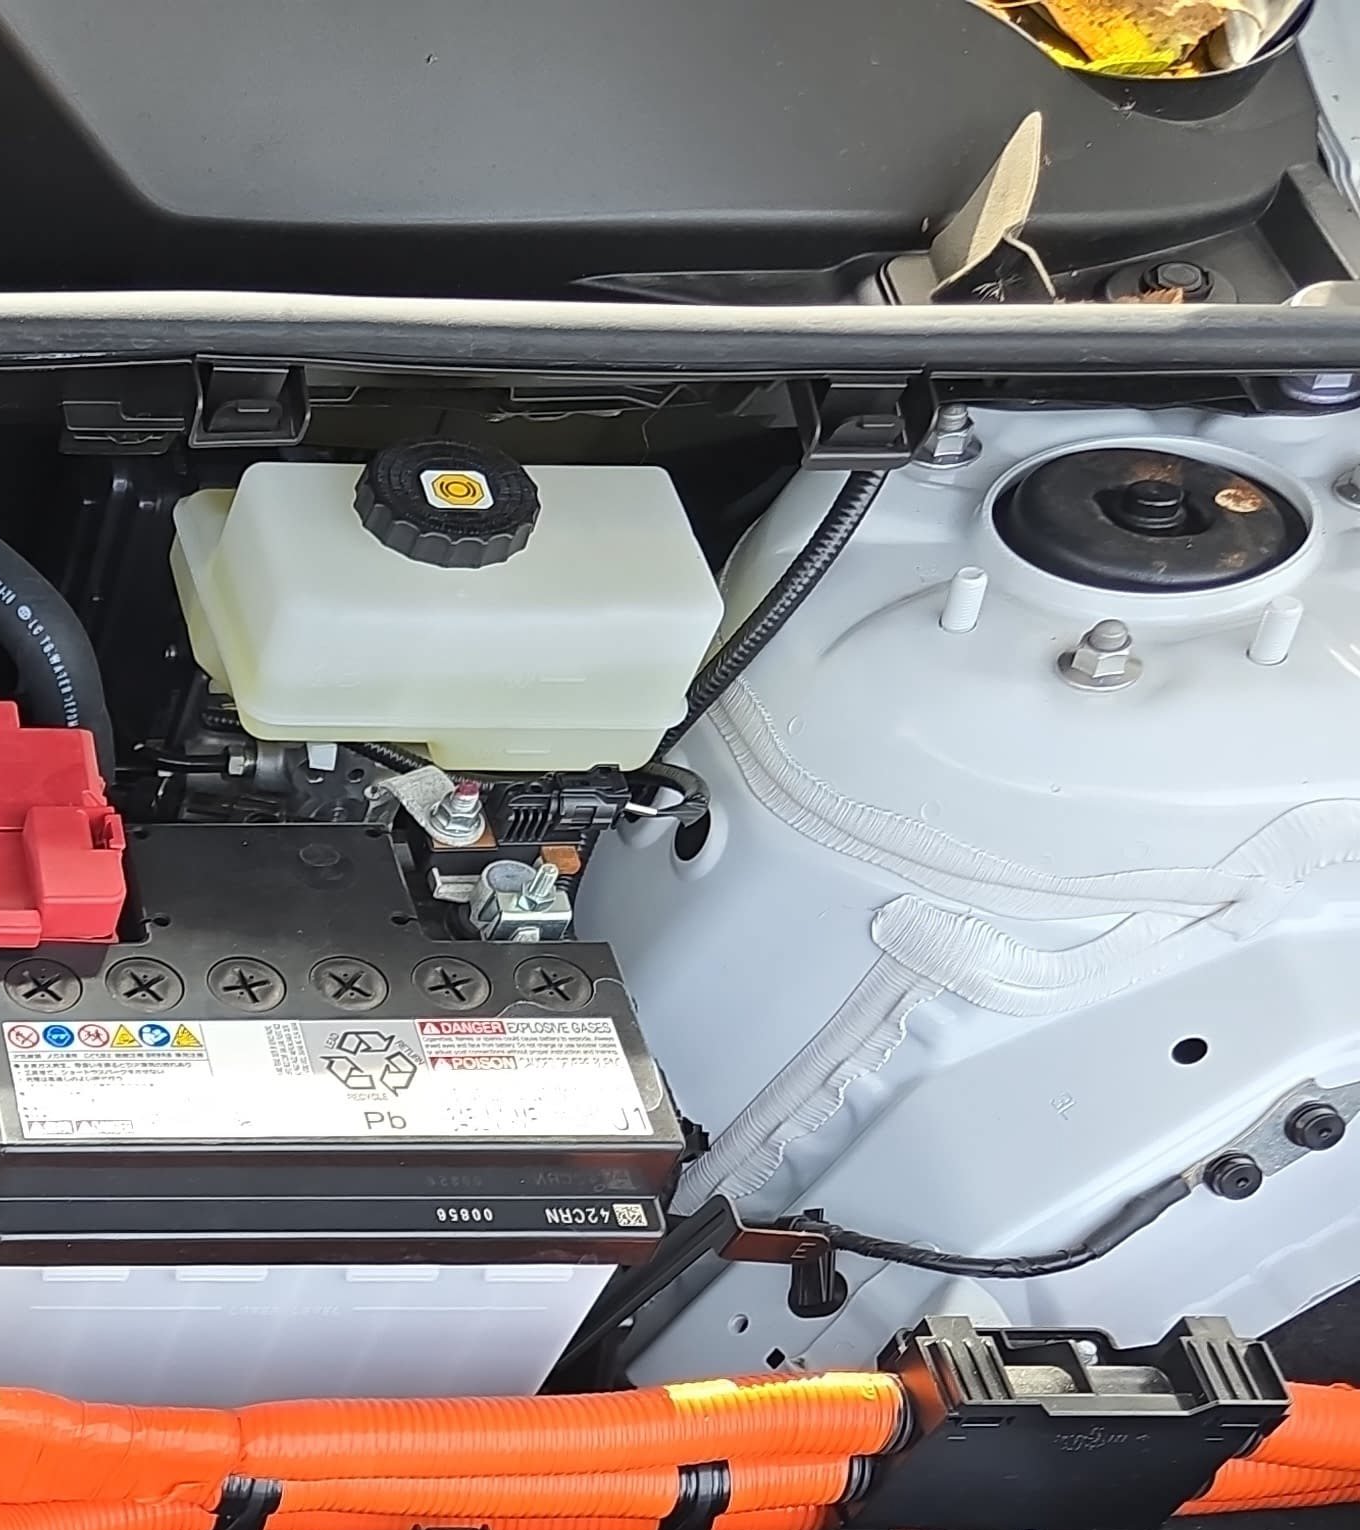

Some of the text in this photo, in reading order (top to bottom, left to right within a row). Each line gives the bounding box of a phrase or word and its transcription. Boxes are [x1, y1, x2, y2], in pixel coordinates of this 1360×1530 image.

[441, 1022, 504, 1034] DANGER
[507, 1022, 611, 1034] EXPLOSIVE GASES
[452, 1057, 516, 1070] POISON
[364, 1111, 407, 1130] Pb
[545, 1207, 610, 1225] 42CRN
